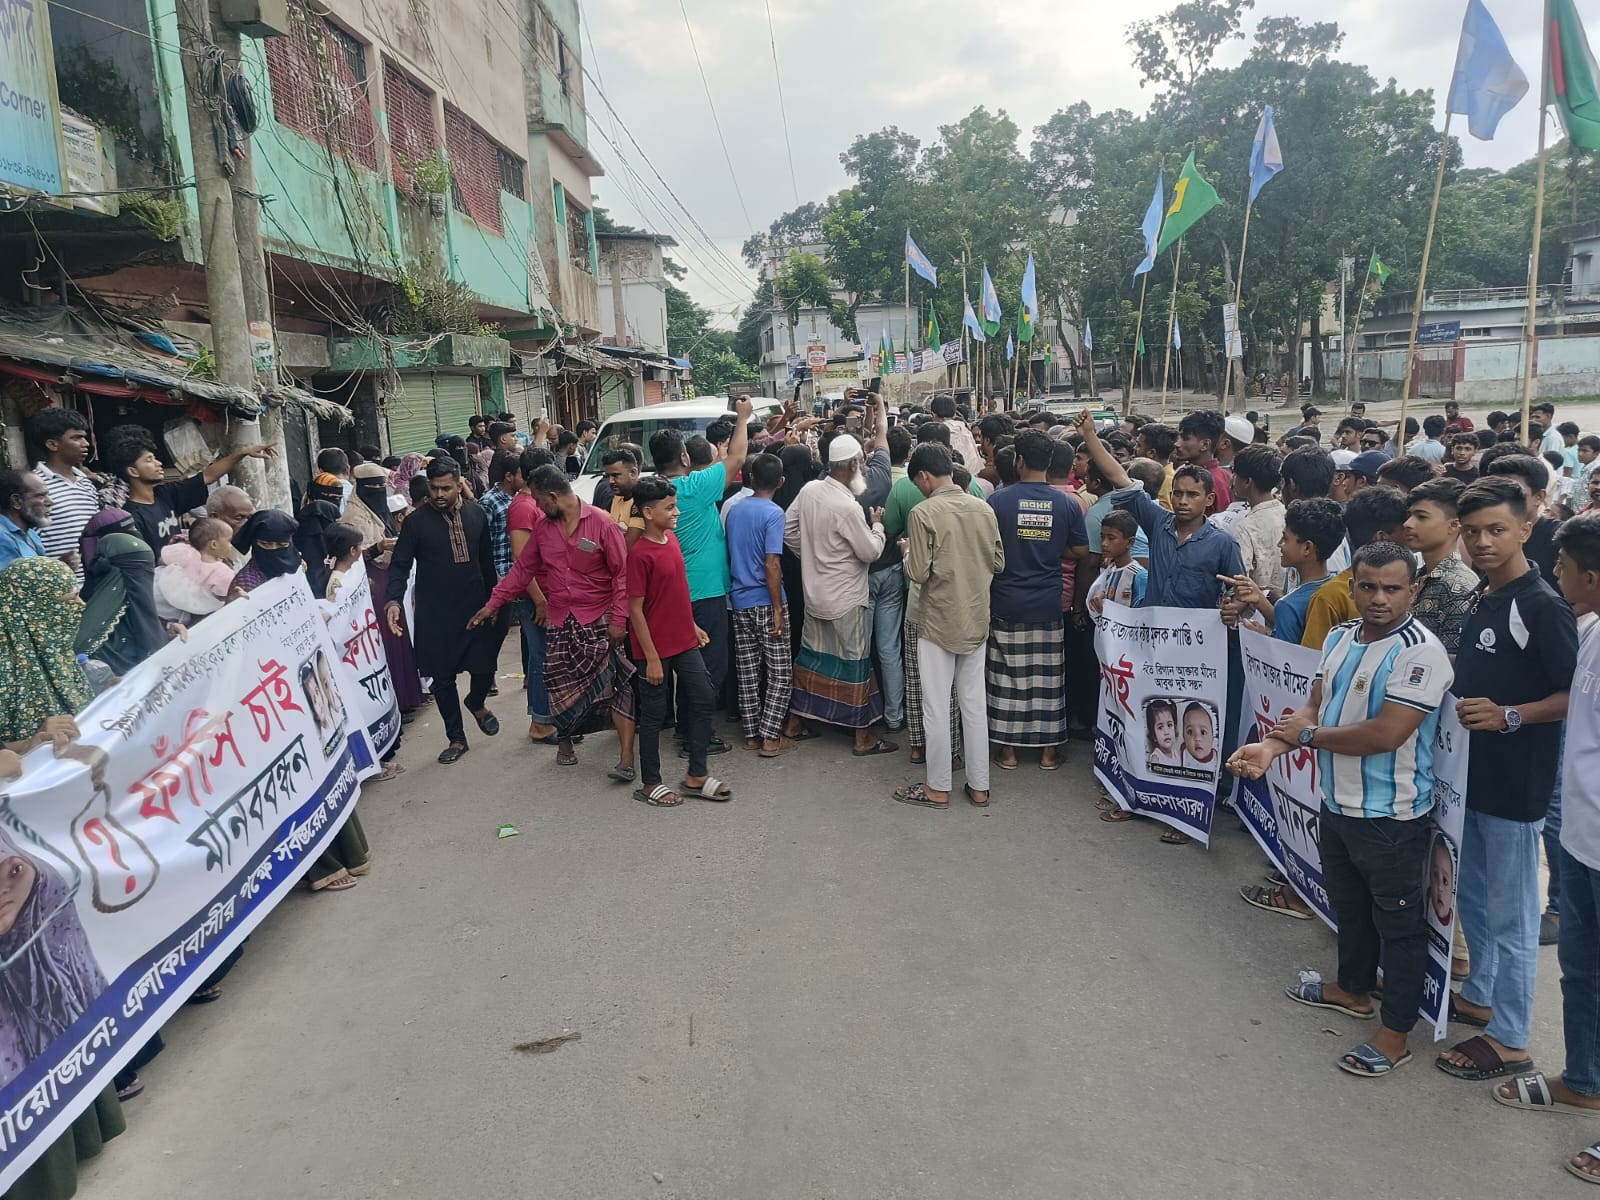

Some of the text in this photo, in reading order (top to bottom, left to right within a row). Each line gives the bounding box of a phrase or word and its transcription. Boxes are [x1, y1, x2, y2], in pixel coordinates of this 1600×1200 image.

[0, 81, 47, 121] Corner
[1172, 622, 1192, 646] শাস্তি
[1195, 629, 1204, 645] ও
[1283, 662, 1308, 697] মীমের
[128, 658, 304, 824] ফাঁসি চাই
[186, 733, 313, 873] মানববন্ধন
[123, 893, 236, 1019] এলাকাবাসীর
[240, 855, 272, 898] পক্ষে
